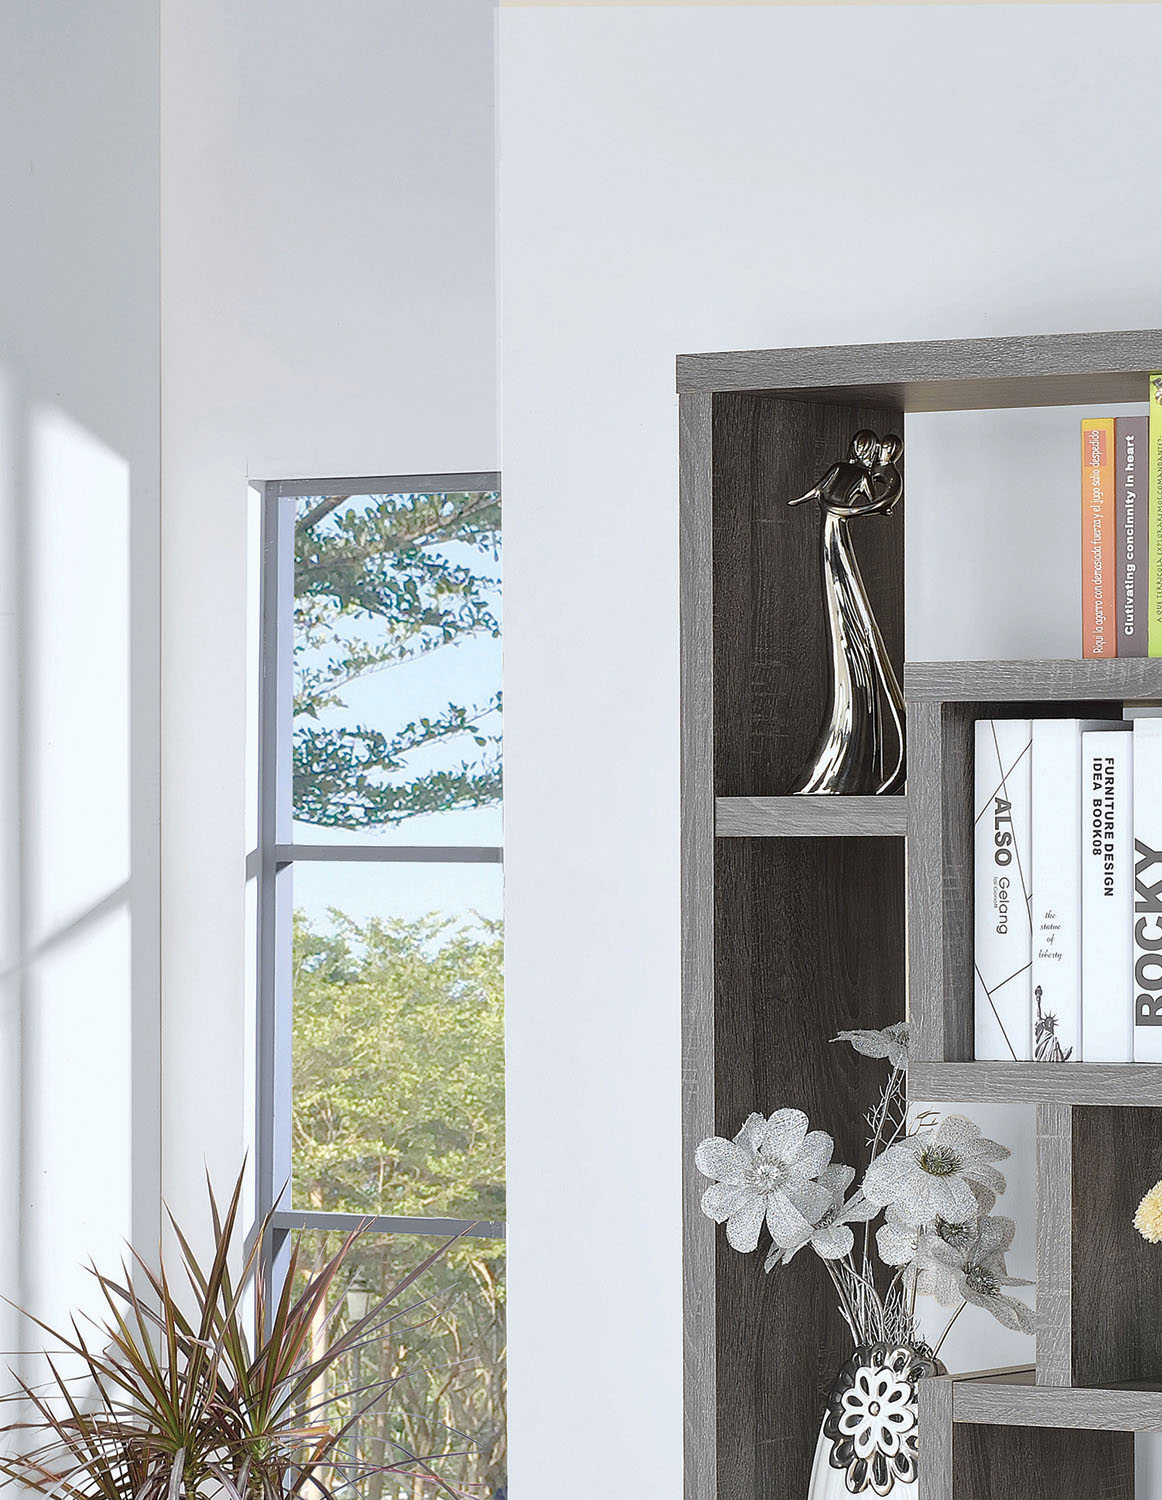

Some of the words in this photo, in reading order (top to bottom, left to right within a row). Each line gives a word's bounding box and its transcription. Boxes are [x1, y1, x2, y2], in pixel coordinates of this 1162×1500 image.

[1088, 430, 1103, 467] despedido
[1124, 435, 1134, 471] heart
[1125, 474, 1134, 487] in
[1089, 487, 1104, 504] jugo
[1090, 505, 1101, 513] el
[1090, 520, 1103, 545] fuerza
[1124, 490, 1136, 560] concinnity
[1094, 585, 1103, 600] con
[1092, 758, 1103, 791] IDEA
[1104, 757, 1115, 840] FURNITURE
[994, 796, 1013, 867] ALSO
[1092, 799, 1103, 856] BOOK08
[1104, 844, 1115, 897] DESIGN
[996, 877, 1011, 935] Gelang
[1044, 910, 1057, 919] the
[1040, 923, 1062, 931] statue
[1046, 933, 1056, 945] of
[1038, 950, 1063, 961] liberty
